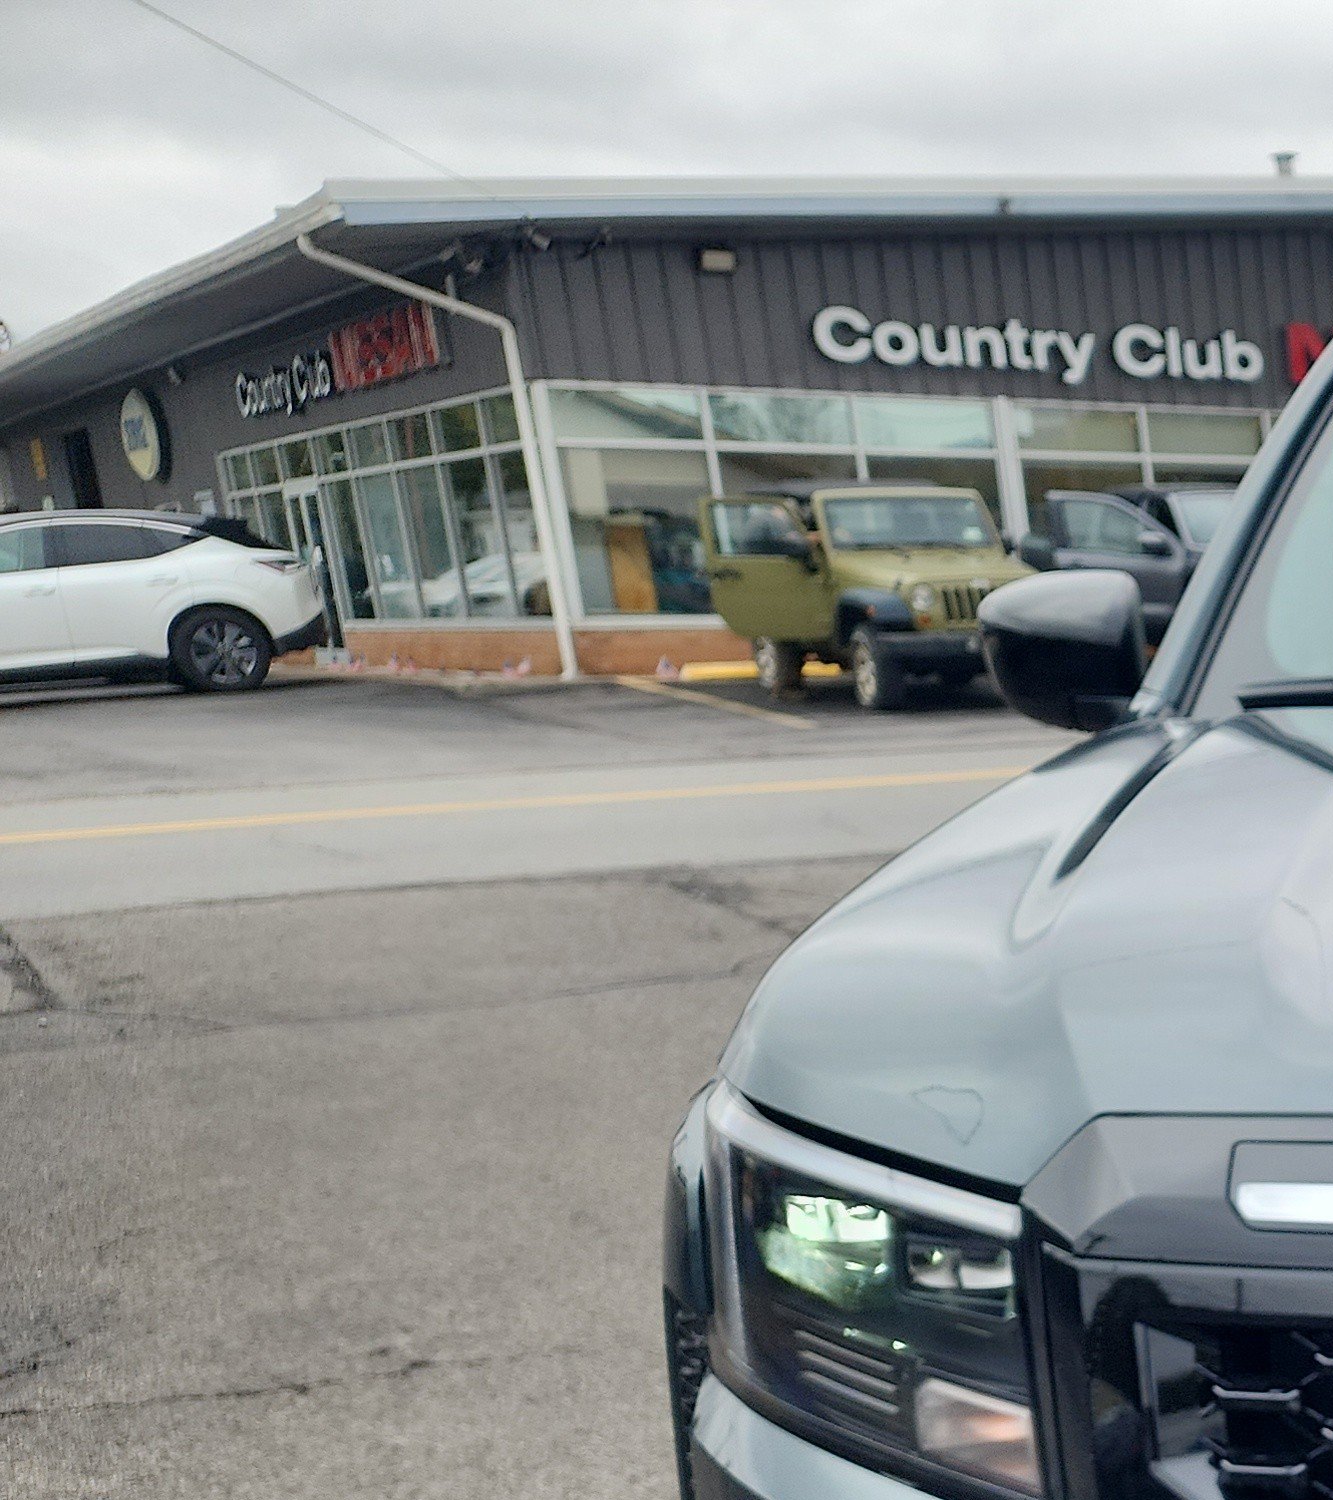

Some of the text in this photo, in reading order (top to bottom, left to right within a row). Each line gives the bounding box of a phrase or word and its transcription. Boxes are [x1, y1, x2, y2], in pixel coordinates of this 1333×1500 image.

[812, 305, 1096, 385] Country
[1112, 323, 1265, 382] Club
[234, 371, 293, 418] Country
